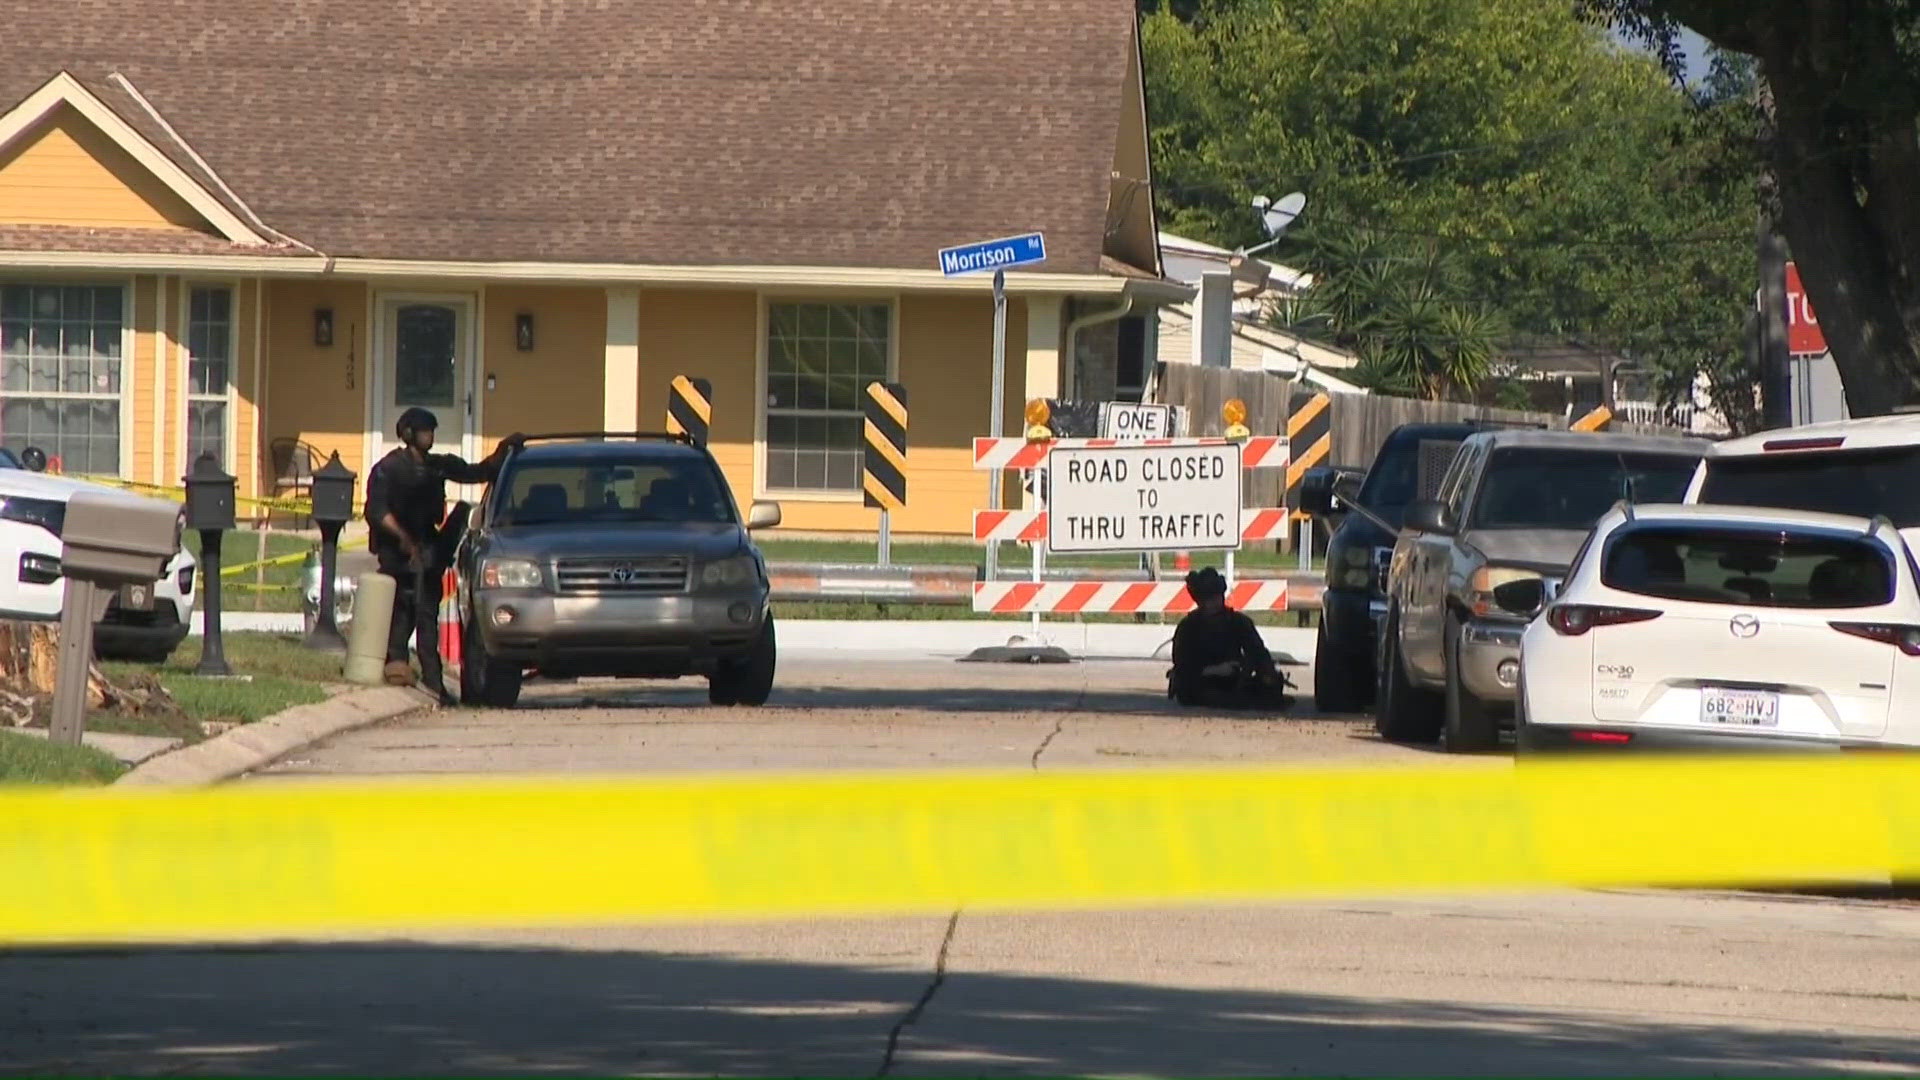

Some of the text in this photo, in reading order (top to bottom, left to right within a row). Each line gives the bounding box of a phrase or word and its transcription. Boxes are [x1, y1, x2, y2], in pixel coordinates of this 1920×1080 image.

[944, 237, 1040, 272] Morrison Rd
[1118, 410, 1157, 431] ONE
[1069, 456, 1224, 483] ROAD CLOSED
[1137, 489, 1158, 509] TO
[1067, 513, 1224, 540] THRU TRAFFIC
[1597, 664, 1635, 674] CX-30
[1745, 698, 1775, 717] HVJ
